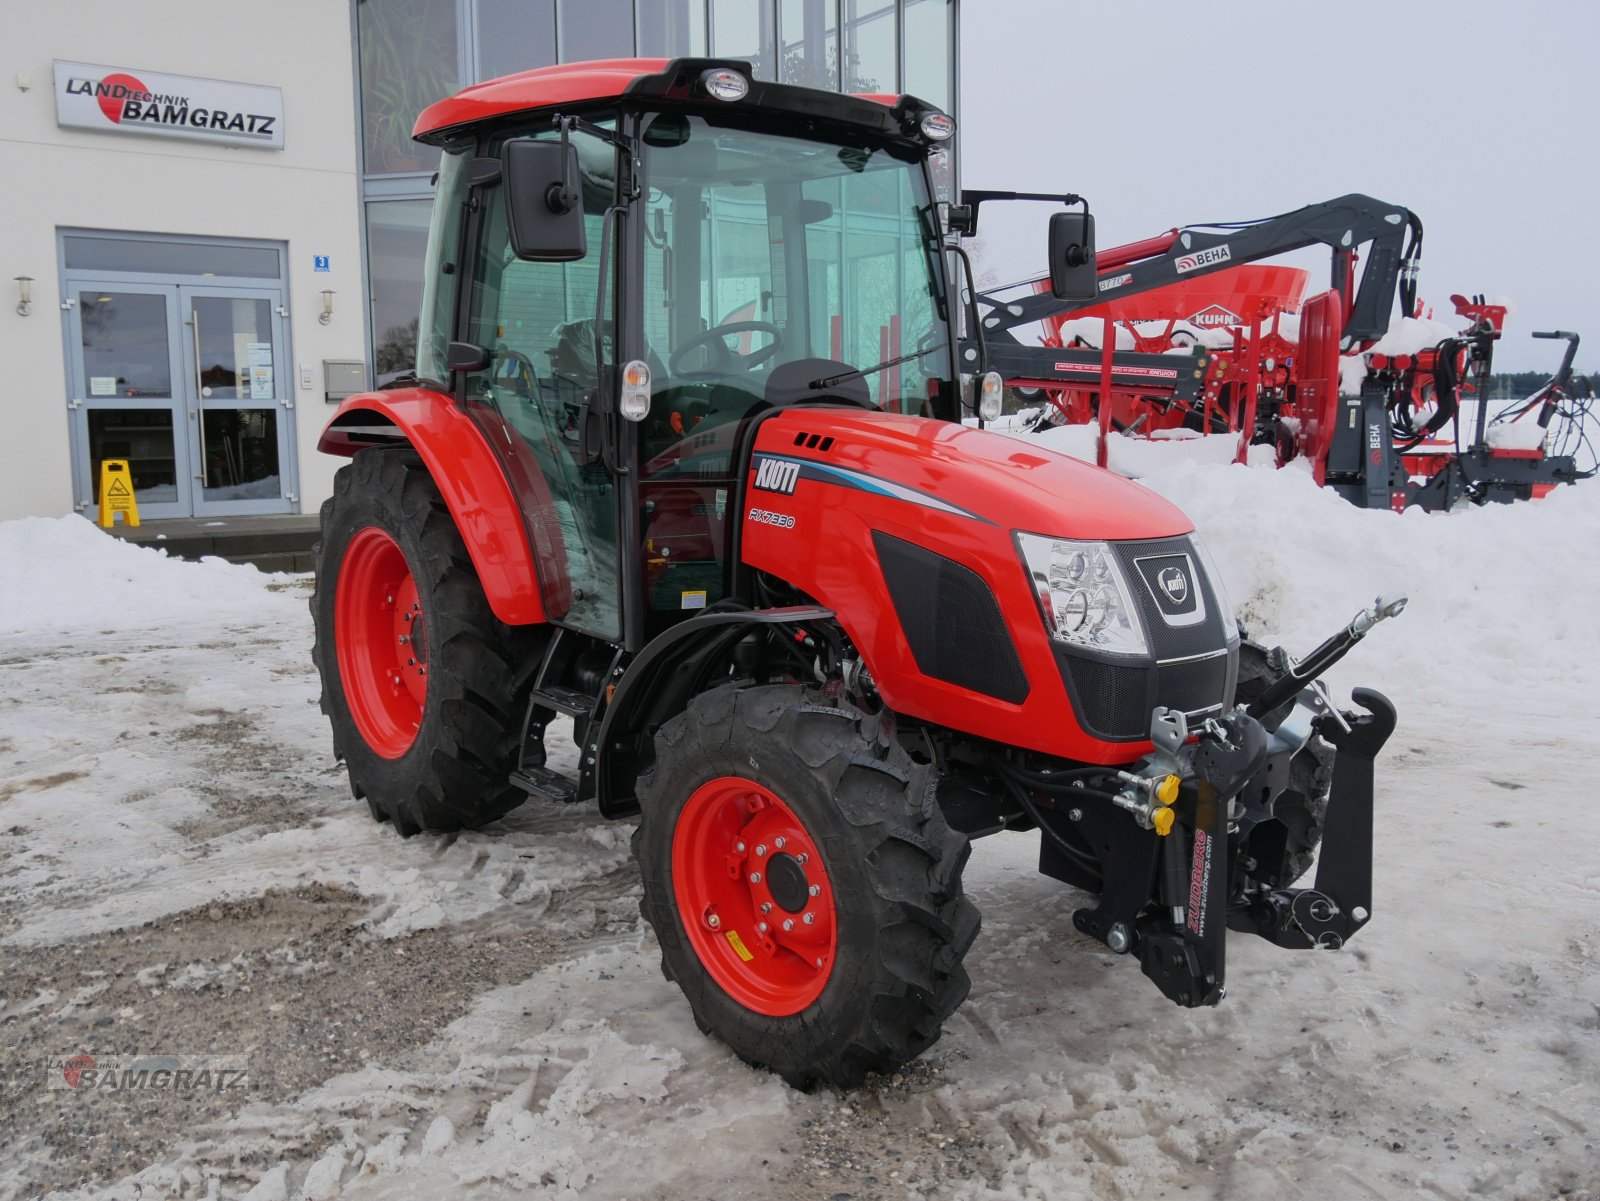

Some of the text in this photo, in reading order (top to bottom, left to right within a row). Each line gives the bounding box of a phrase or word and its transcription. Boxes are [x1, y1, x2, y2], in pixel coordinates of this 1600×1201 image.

[66, 78, 190, 107] LANDTECHNIK
[121, 100, 277, 135] BAMGRATZ
[319, 257, 325, 267] 3
[1196, 247, 1230, 266] BEHA
[1195, 314, 1234, 325] KUHN
[1369, 424, 1381, 449] BEHA
[755, 458, 801, 493] KIOTI
[748, 508, 796, 529] RX7330
[1187, 828, 1207, 935] ZUIDBERG
[1198, 834, 1213, 938] www.zuidberg.com
